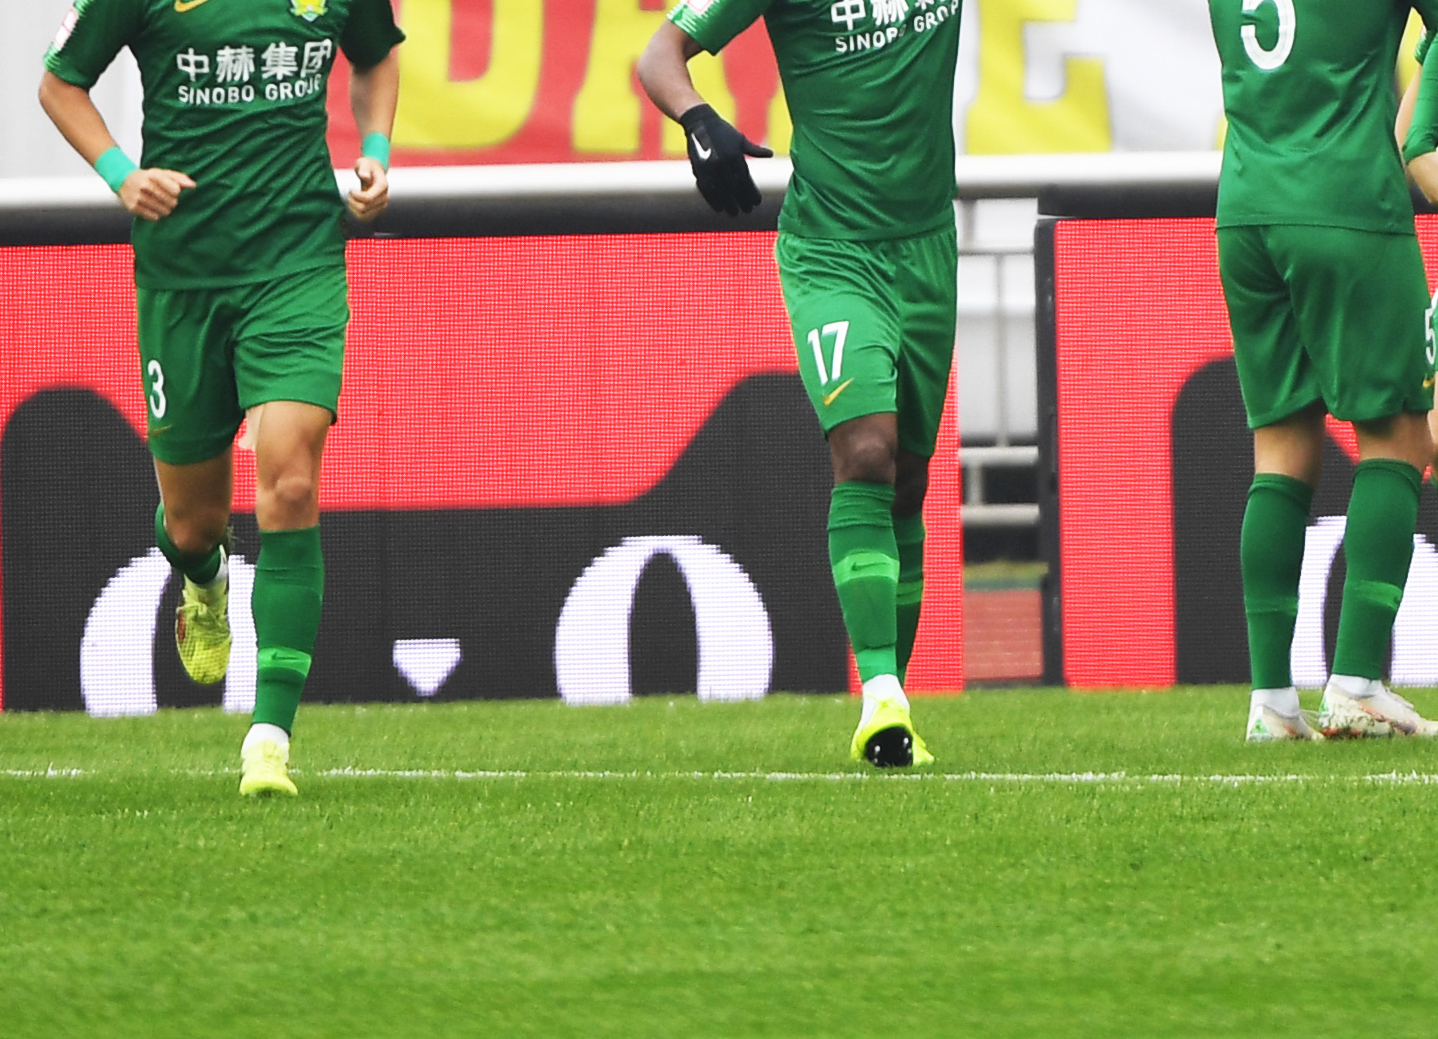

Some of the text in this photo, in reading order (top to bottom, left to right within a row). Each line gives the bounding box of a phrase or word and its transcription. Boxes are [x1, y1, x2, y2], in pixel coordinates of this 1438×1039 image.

[176, 38, 333, 83] 中赫集团
[178, 84, 255, 105] SINOBO
[806, 320, 850, 387] 17
[147, 359, 167, 418] 3
